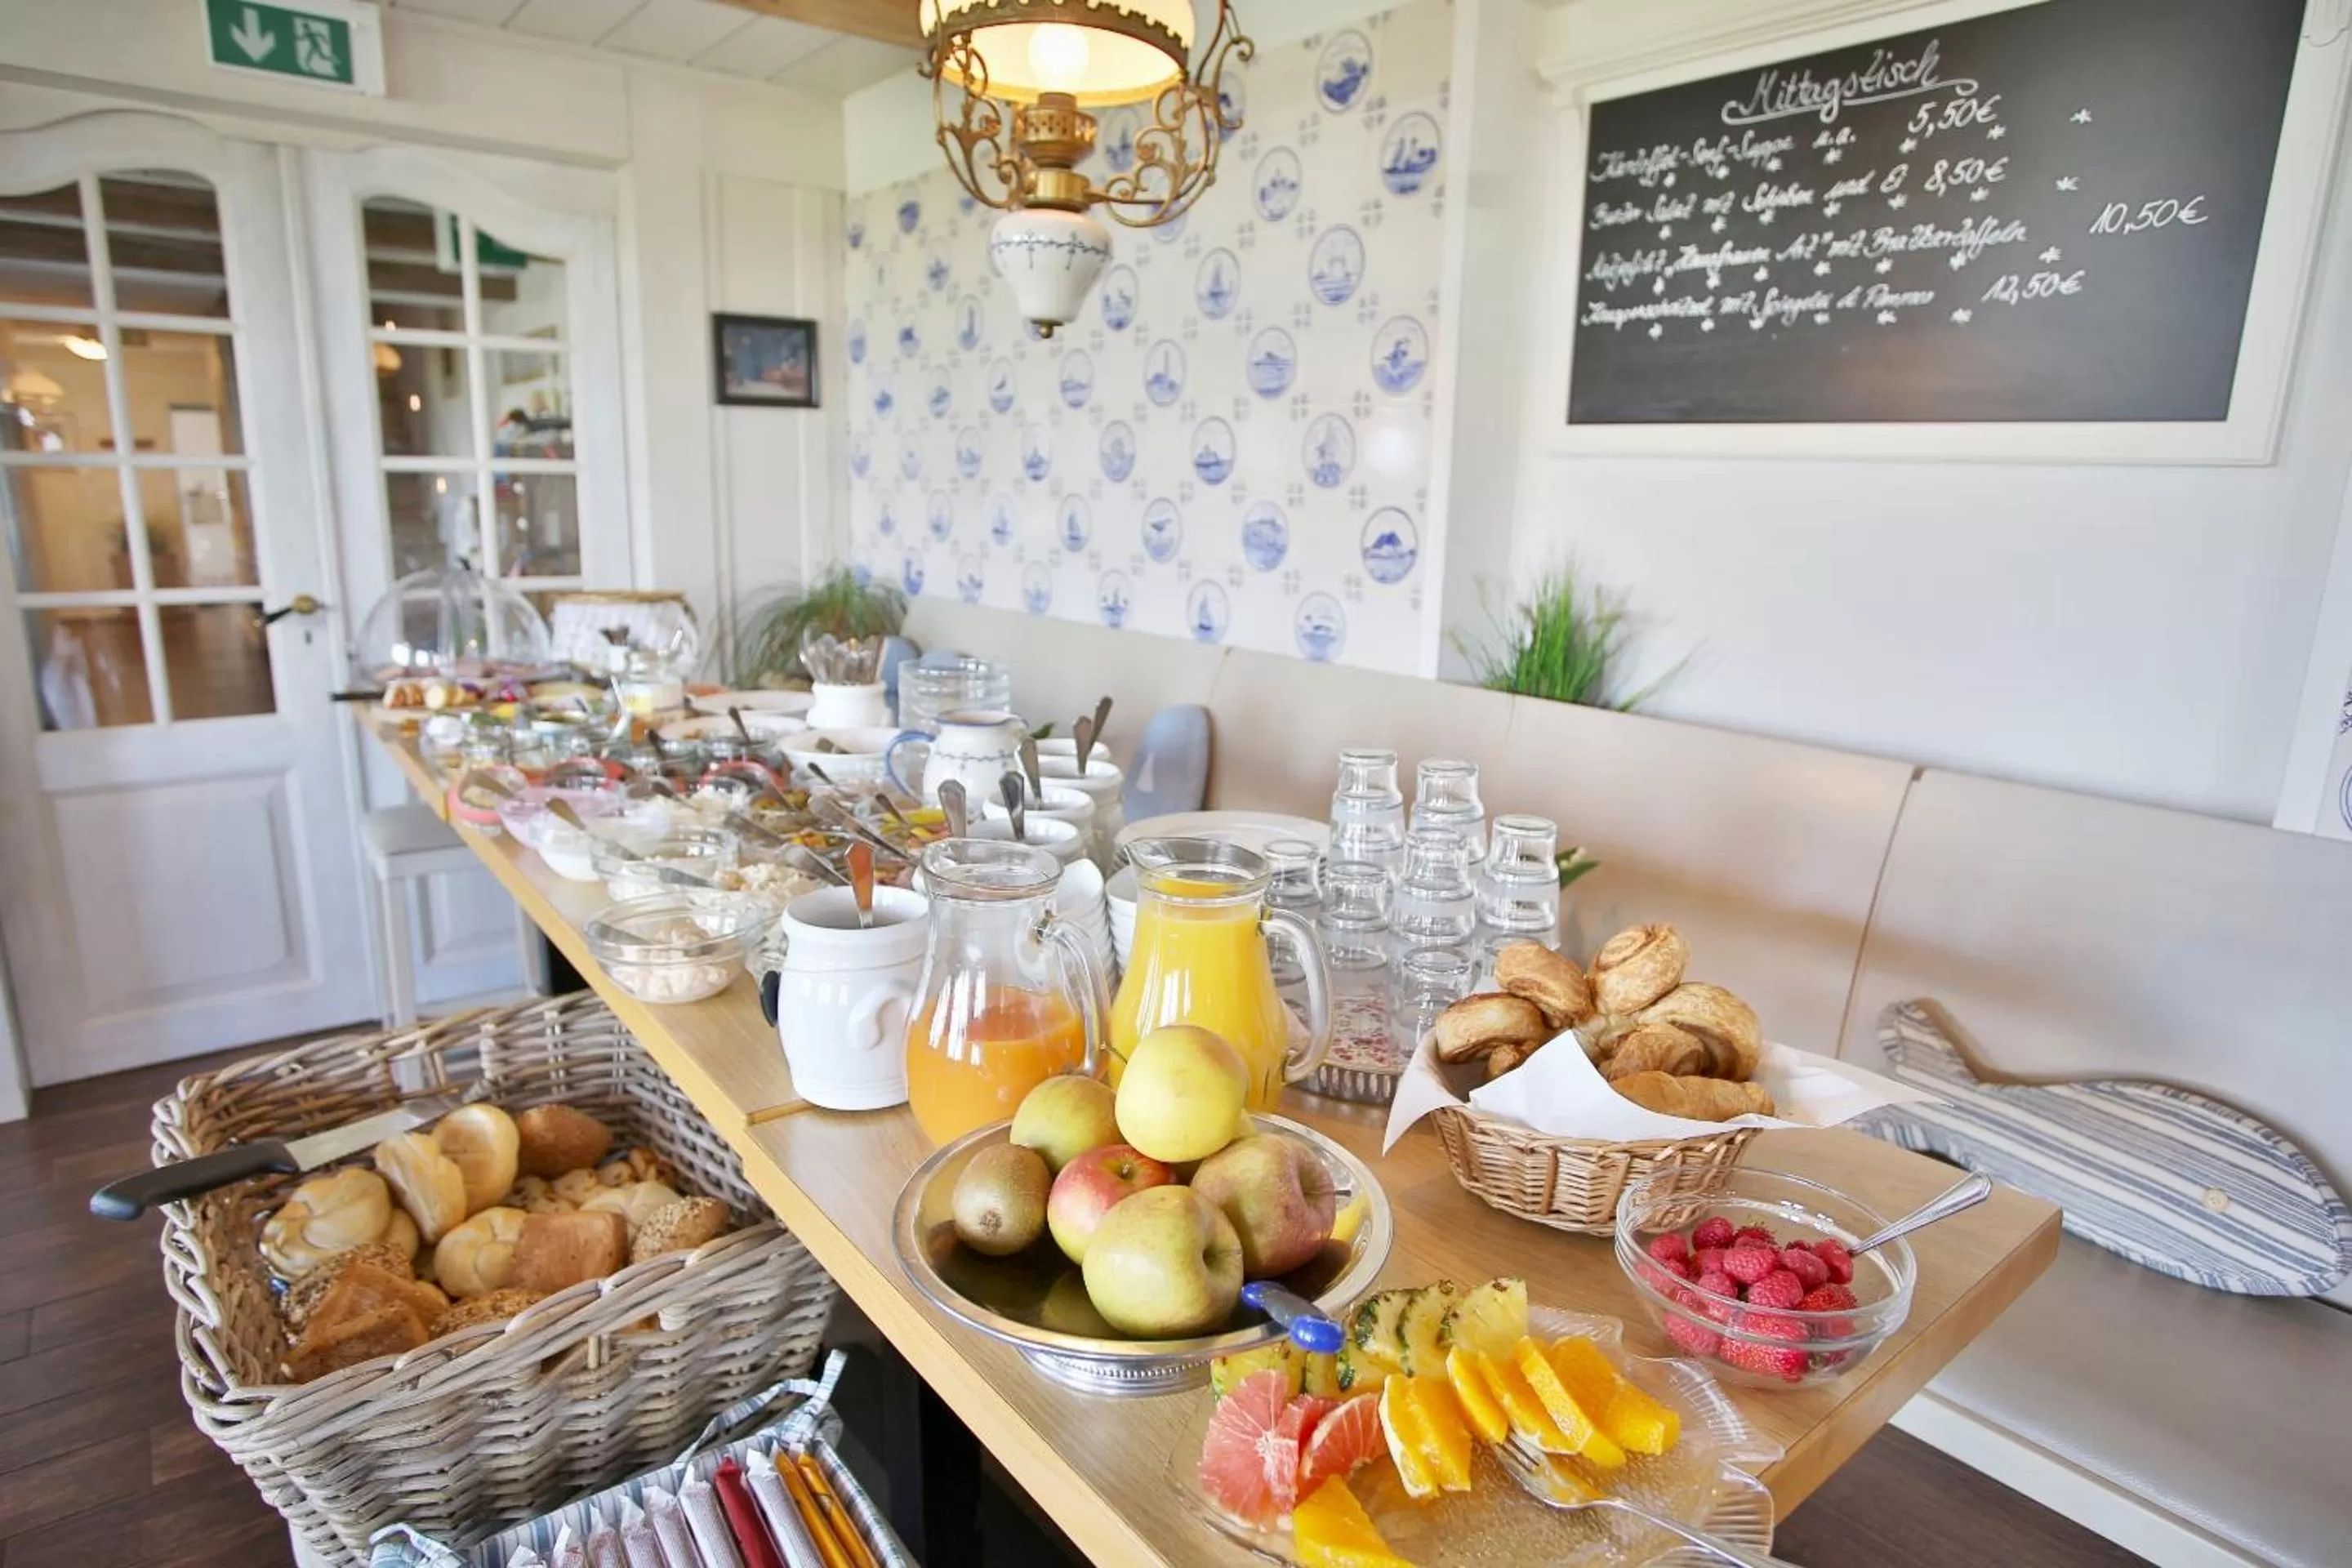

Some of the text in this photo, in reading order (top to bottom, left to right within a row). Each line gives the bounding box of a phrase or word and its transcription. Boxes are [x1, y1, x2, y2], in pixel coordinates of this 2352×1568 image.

[1728, 38, 1944, 123] Mittagstisch
[1908, 95, 2001, 138] 5,50€
[1823, 169, 1875, 201] und
[1924, 156, 2009, 197] 8,50€
[2089, 195, 2208, 235] 10,50€
[1982, 270, 2086, 305] 12,50€
